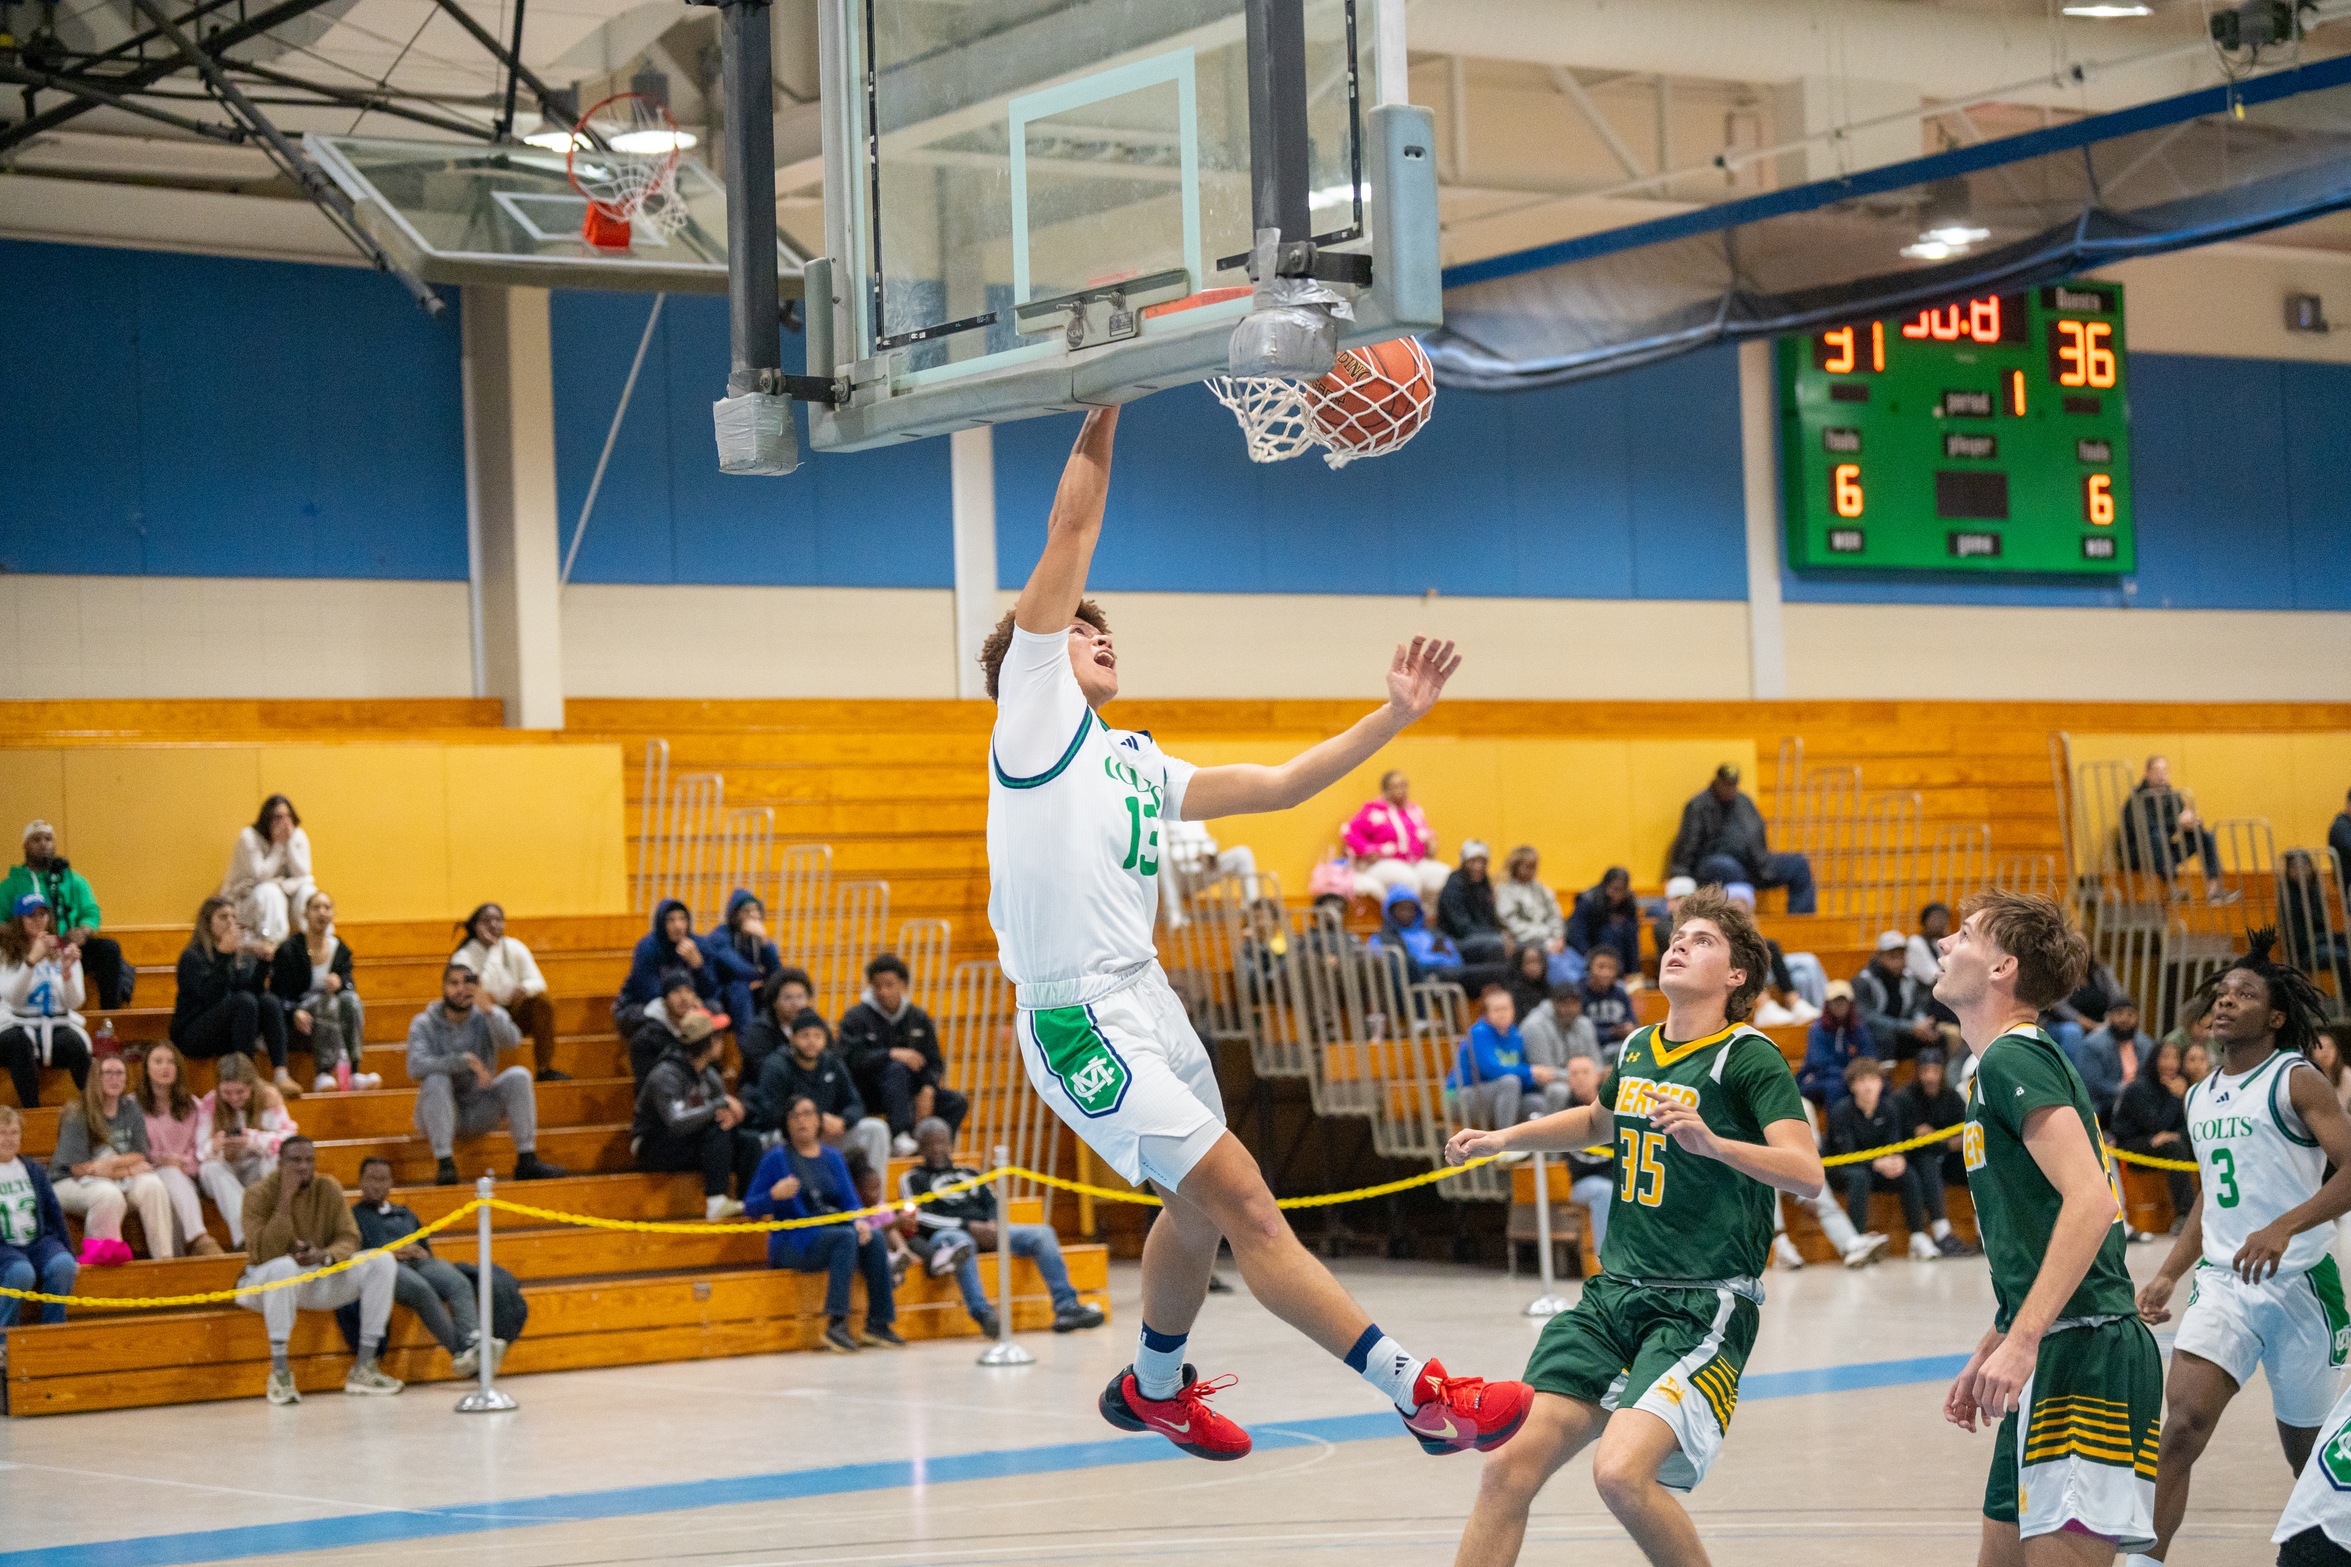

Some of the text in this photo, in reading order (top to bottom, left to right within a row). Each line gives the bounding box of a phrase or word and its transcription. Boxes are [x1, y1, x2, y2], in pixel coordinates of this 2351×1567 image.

[2057, 319, 2116, 388] 36
[2013, 370, 2027, 416] 1
[1835, 464, 1864, 518] 6
[2088, 473, 2115, 525] 6
[2192, 1116, 2253, 1143] COLTS
[1619, 1127, 1666, 1208] 35
[2211, 1148, 2240, 1209] 3
